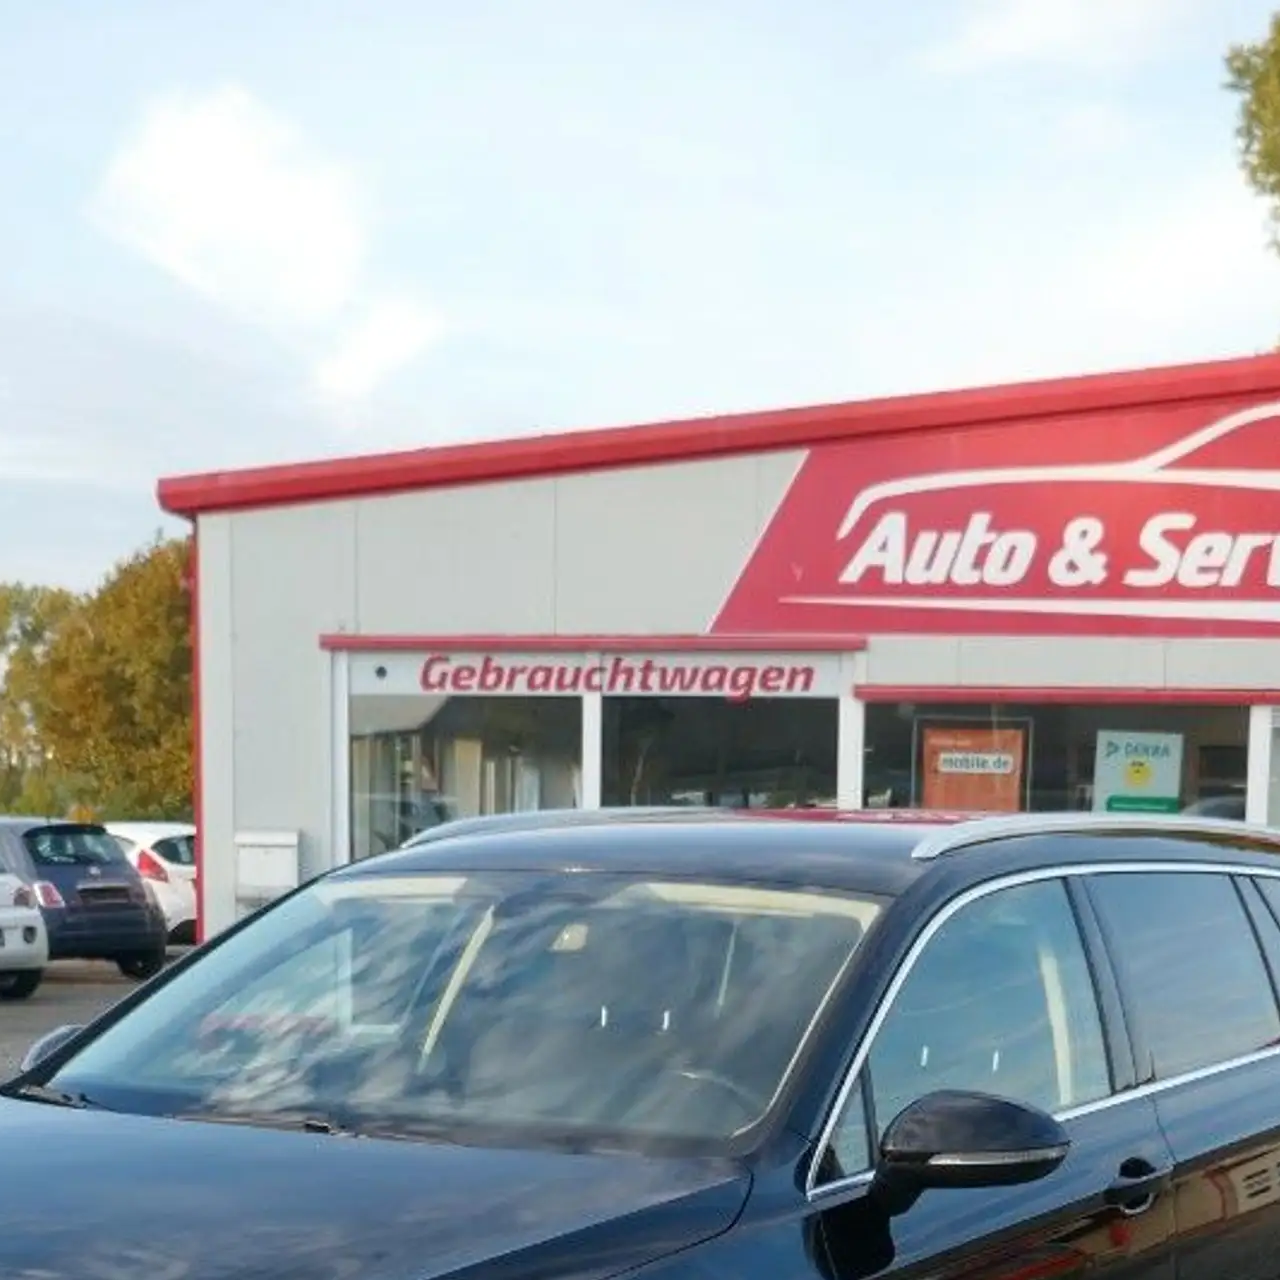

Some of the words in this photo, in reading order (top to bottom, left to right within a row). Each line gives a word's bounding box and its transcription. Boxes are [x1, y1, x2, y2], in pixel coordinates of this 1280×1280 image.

[839, 511, 1038, 586] Auto
[1048, 516, 1108, 588] &
[420, 655, 815, 706] Gebrauchtwagen
[941, 755, 1010, 770] mobile.de
